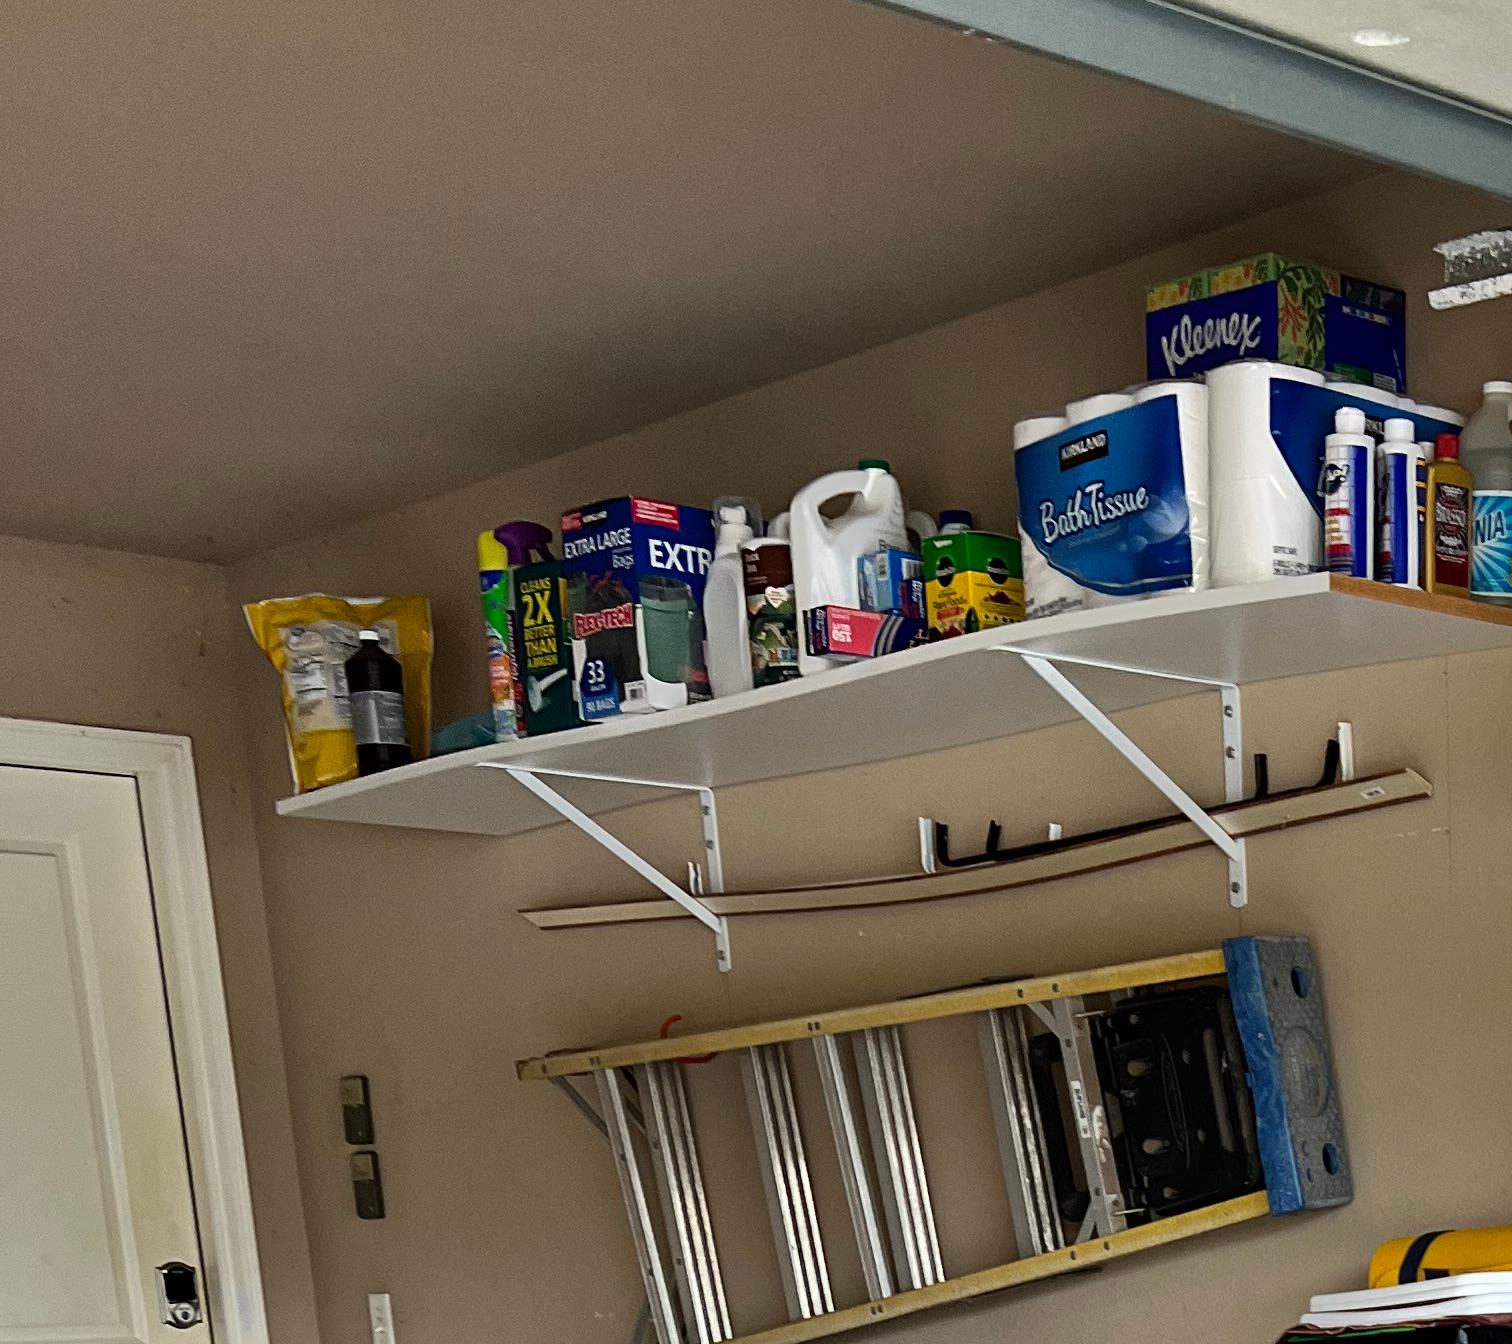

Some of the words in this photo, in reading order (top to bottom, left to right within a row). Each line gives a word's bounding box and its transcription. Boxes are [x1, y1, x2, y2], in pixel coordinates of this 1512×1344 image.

[1161, 311, 1262, 377] Kleenex
[1061, 433, 1108, 461] KIRKLAND
[1039, 490, 1092, 545] Bath
[1084, 481, 1150, 527] Tissue
[564, 536, 595, 559] EXTRA
[596, 527, 632, 551] LARGE
[648, 538, 714, 576] EXTR
[522, 592, 554, 627] 2X
[524, 625, 555, 642] BETTER
[525, 638, 558, 657] THAN
[587, 660, 606, 684] 33
